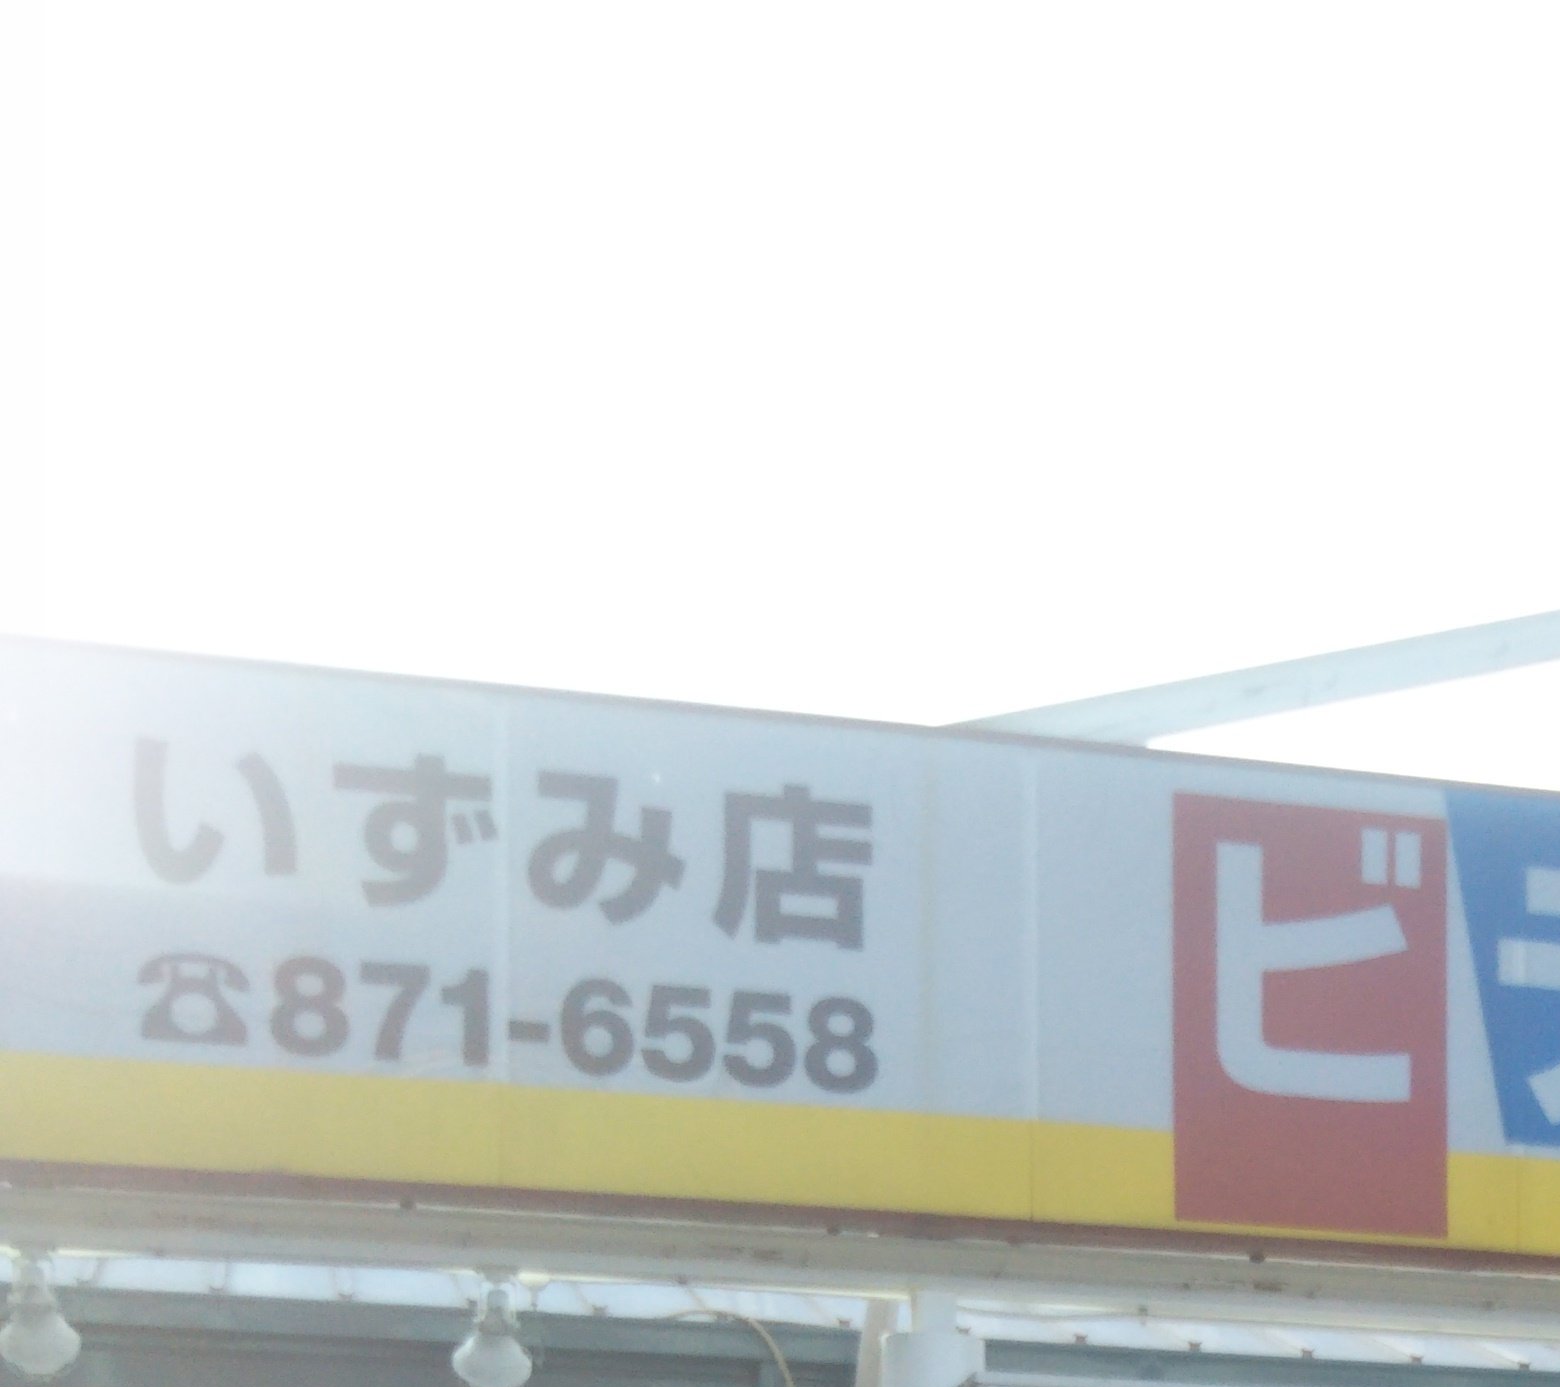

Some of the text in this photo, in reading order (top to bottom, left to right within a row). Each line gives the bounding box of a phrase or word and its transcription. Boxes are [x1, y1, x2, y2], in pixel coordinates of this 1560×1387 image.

[131, 736, 874, 952] いずみ店
[269, 955, 878, 1094] 871-6558
